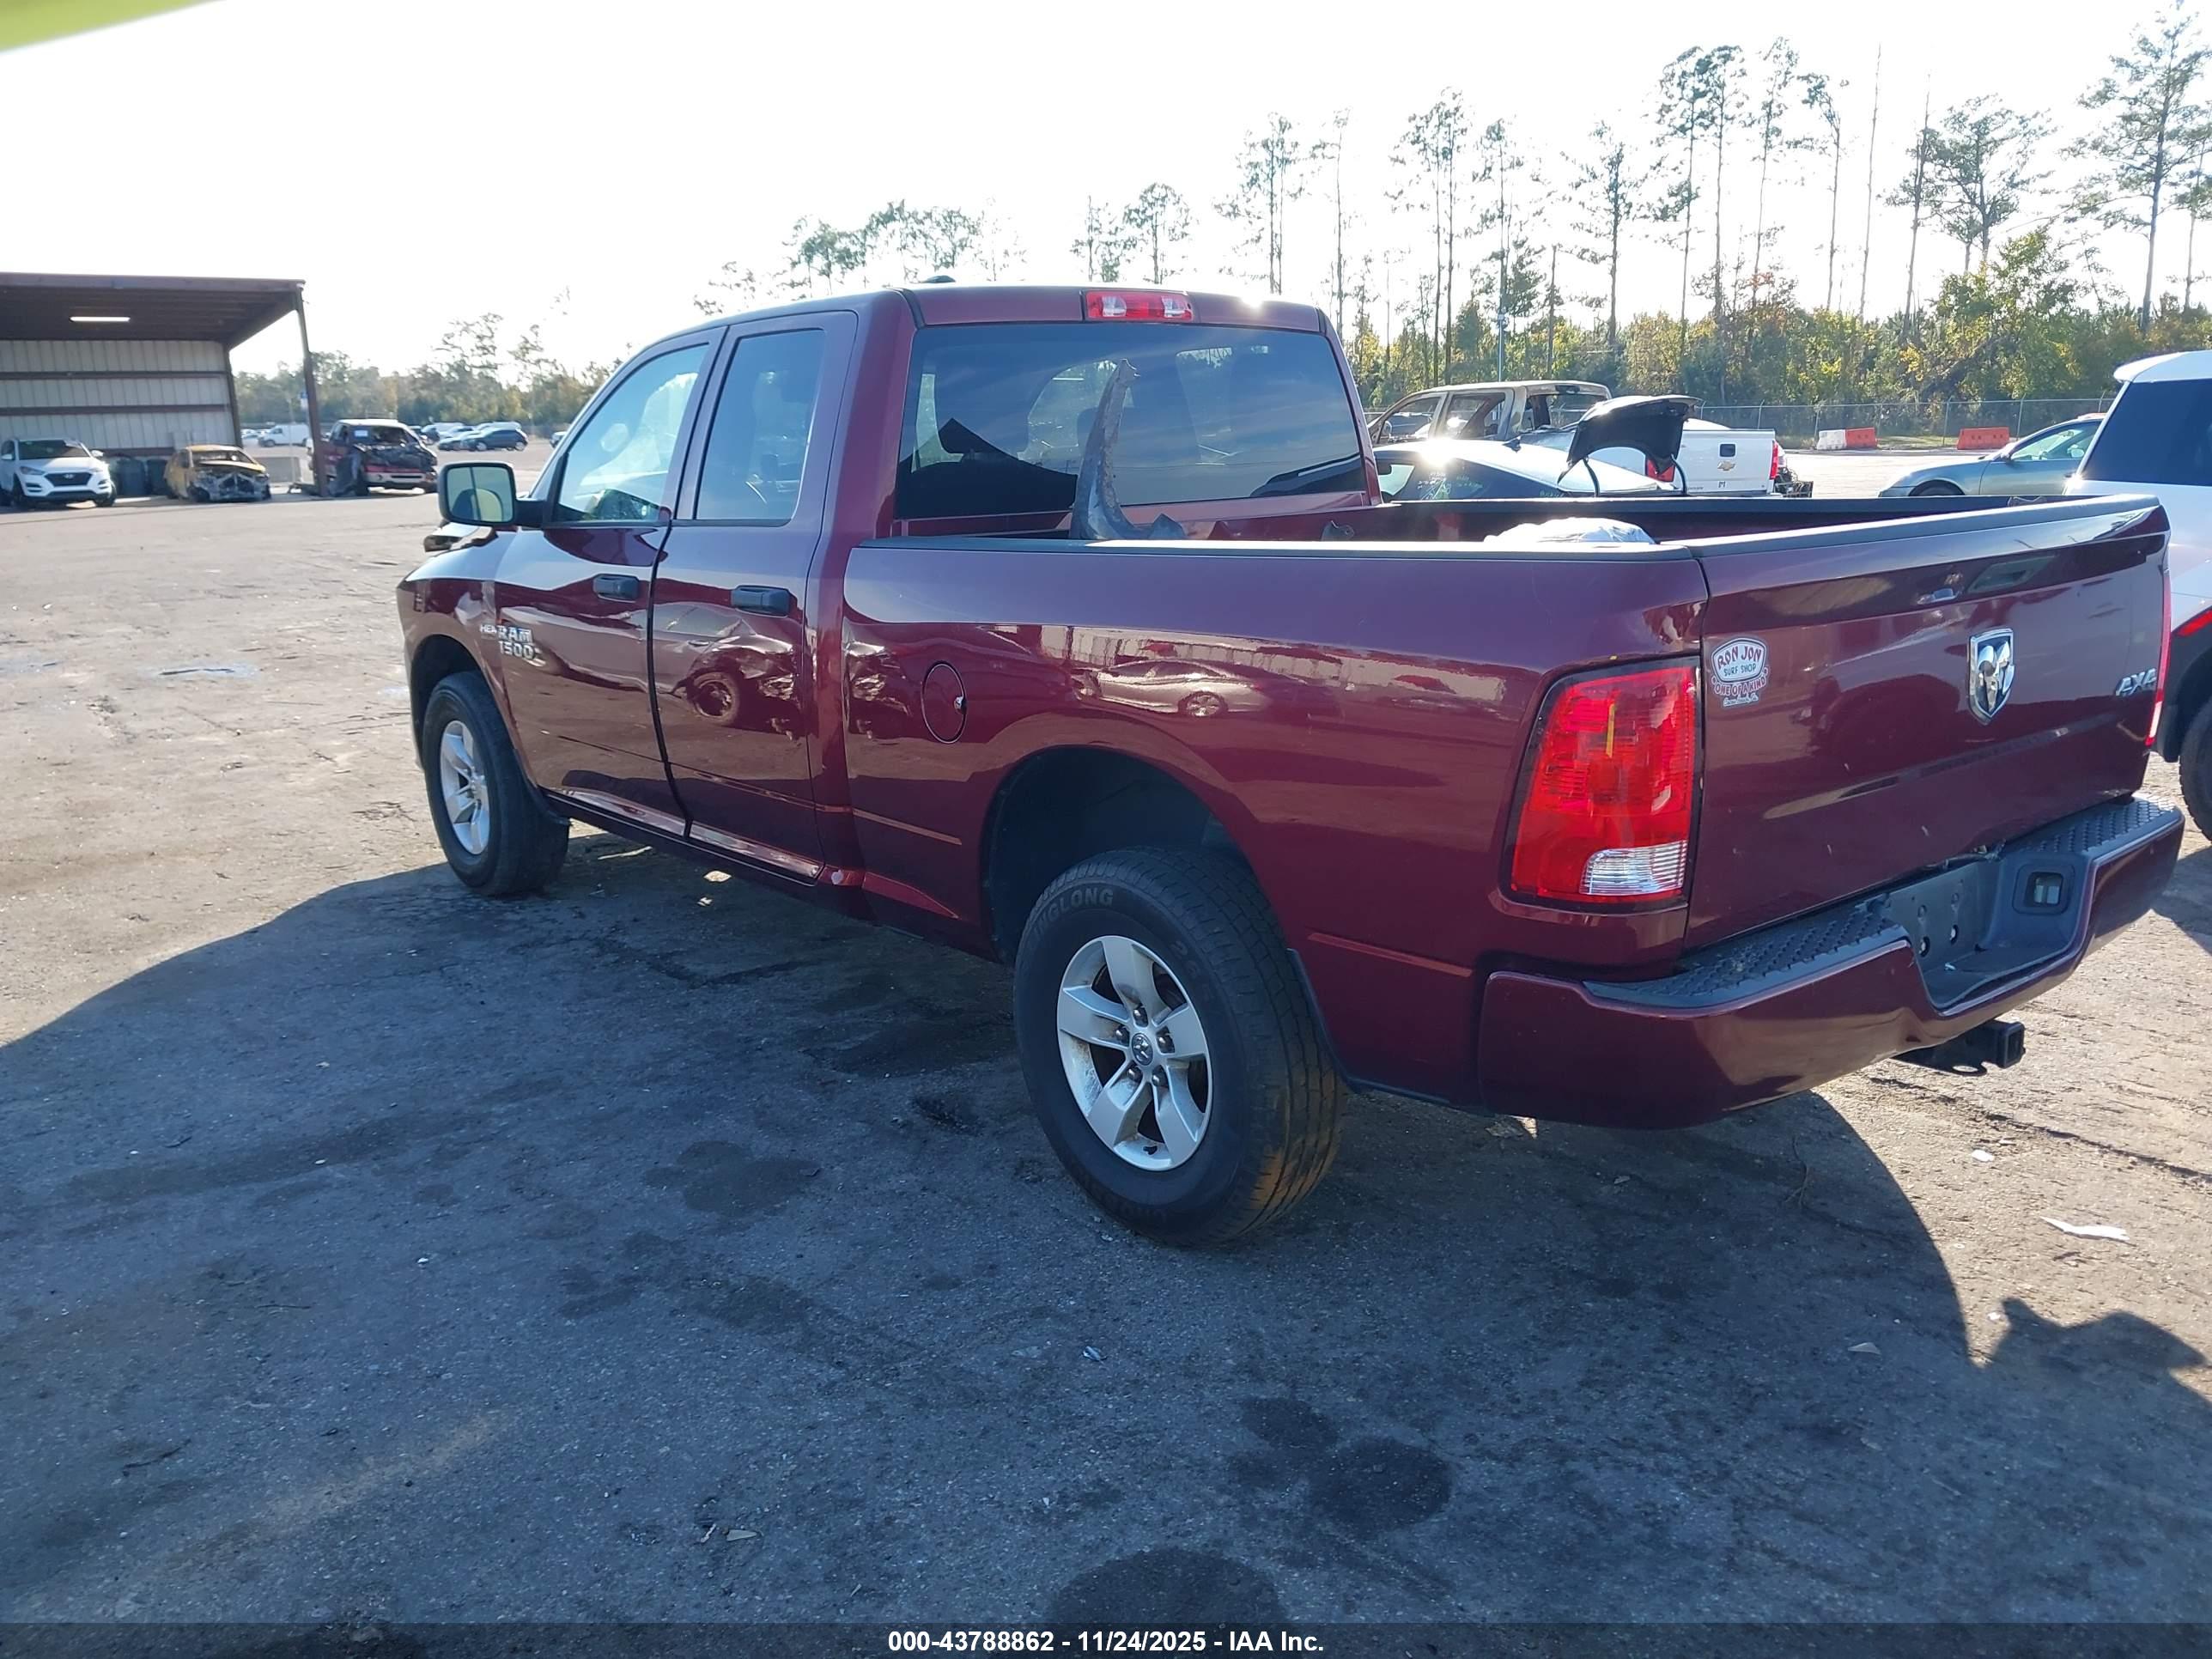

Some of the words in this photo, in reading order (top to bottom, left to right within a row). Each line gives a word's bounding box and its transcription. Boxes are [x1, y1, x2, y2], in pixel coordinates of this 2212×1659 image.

[496, 624, 532, 643] RAM
[498, 641, 534, 660] 1500
[1717, 646, 1739, 671] RON
[1741, 646, 1762, 663] JON
[1723, 665, 1738, 677] SURF
[1741, 663, 1757, 673] SHOP
[1714, 683, 1731, 696] ONE
[1749, 675, 1766, 692] KIND
